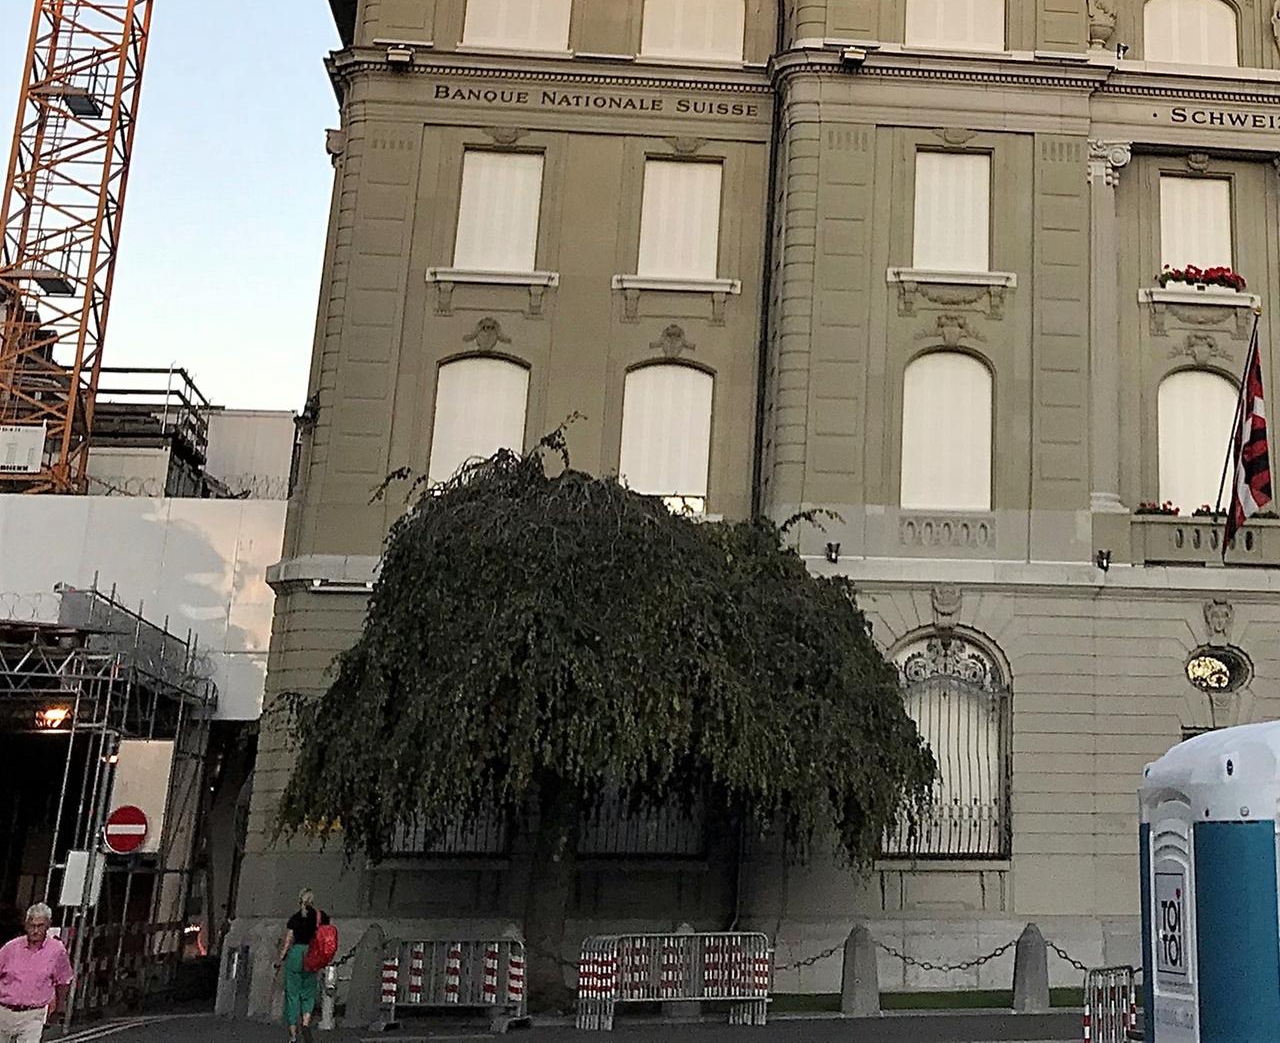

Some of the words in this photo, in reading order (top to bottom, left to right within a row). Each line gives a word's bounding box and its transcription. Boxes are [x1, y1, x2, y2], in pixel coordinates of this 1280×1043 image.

[434, 85, 529, 103] BANQUE
[541, 91, 663, 111] NATIONALE
[676, 100, 758, 117] SUISSE
[1162, 934, 1182, 967] TOI
